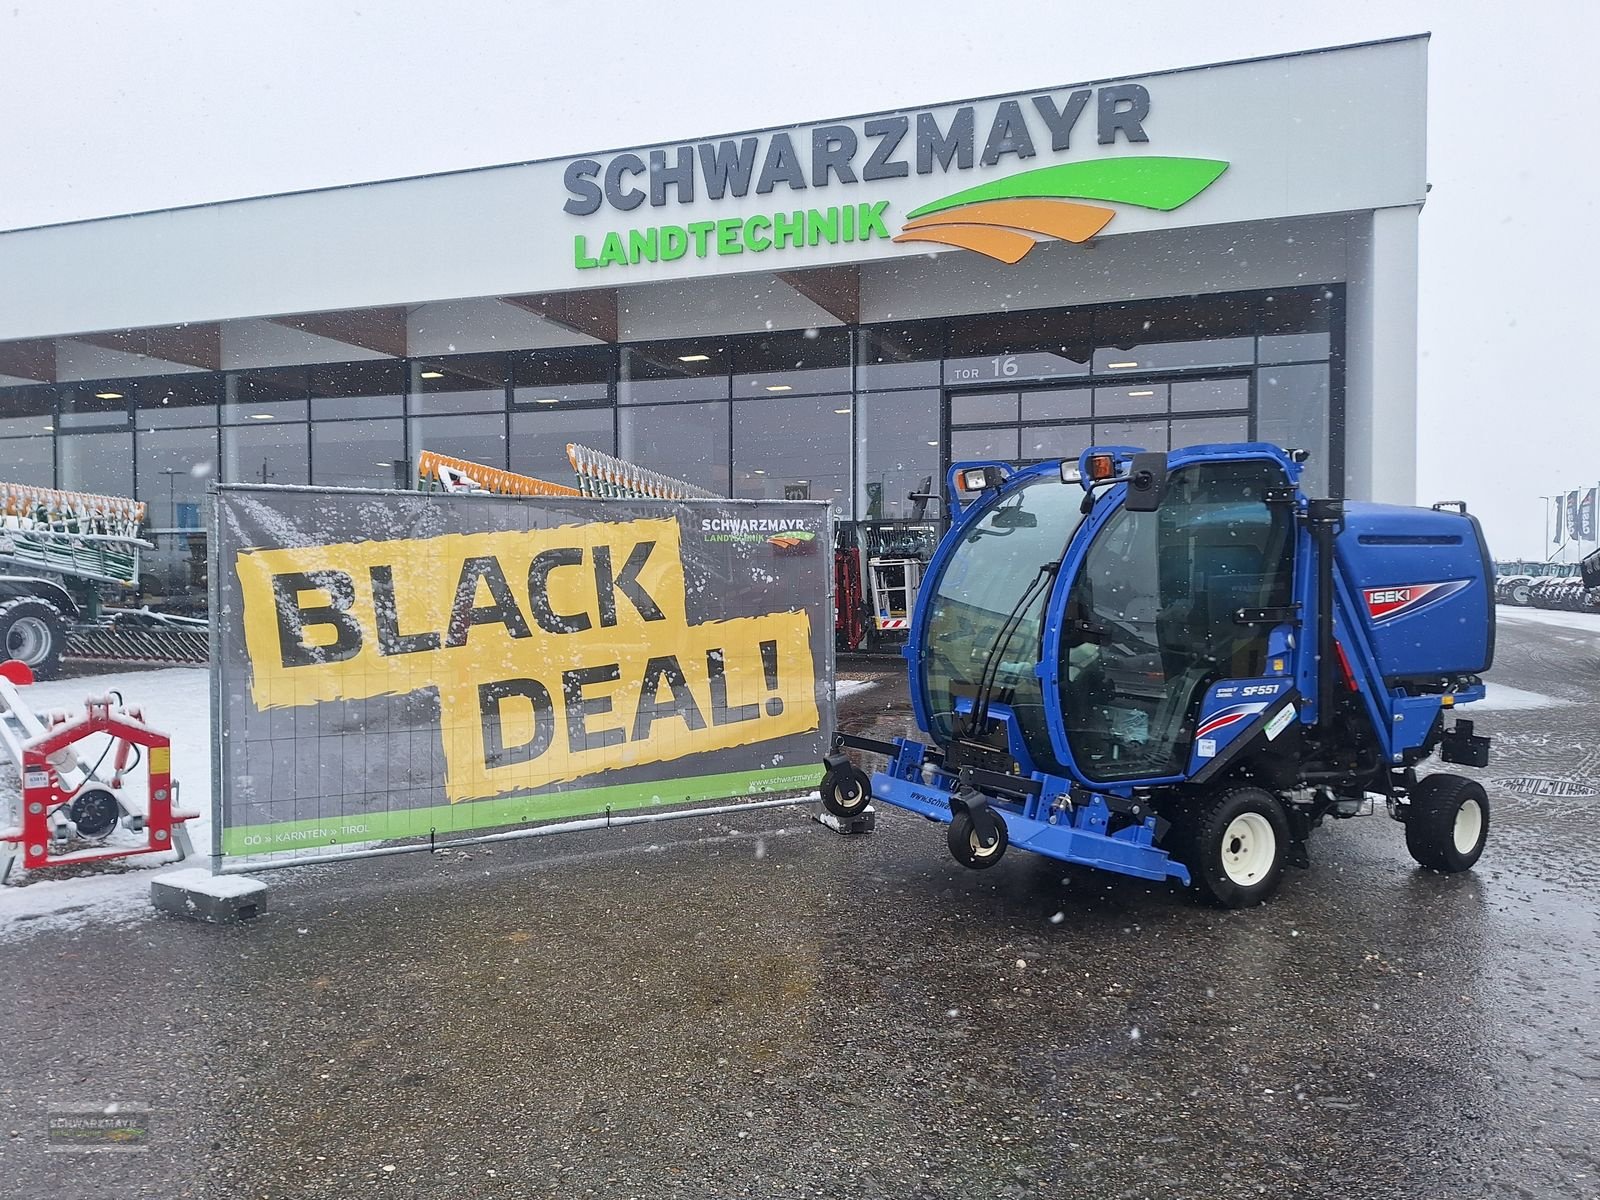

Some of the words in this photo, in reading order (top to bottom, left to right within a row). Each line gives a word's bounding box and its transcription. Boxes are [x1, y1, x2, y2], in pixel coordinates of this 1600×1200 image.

[563, 84, 1151, 216] SCHWARZMAYR
[574, 200, 892, 270] LANDTECHNIK
[954, 369, 980, 379] TOR
[991, 356, 1018, 377] 16
[702, 518, 805, 532] SCHWARZMAYR
[271, 541, 667, 668] BLACK
[1369, 589, 1411, 604] ISEKI
[1241, 684, 1280, 697] SF551
[478, 640, 785, 770] DEAL!
[341, 824, 369, 834] TIROL
